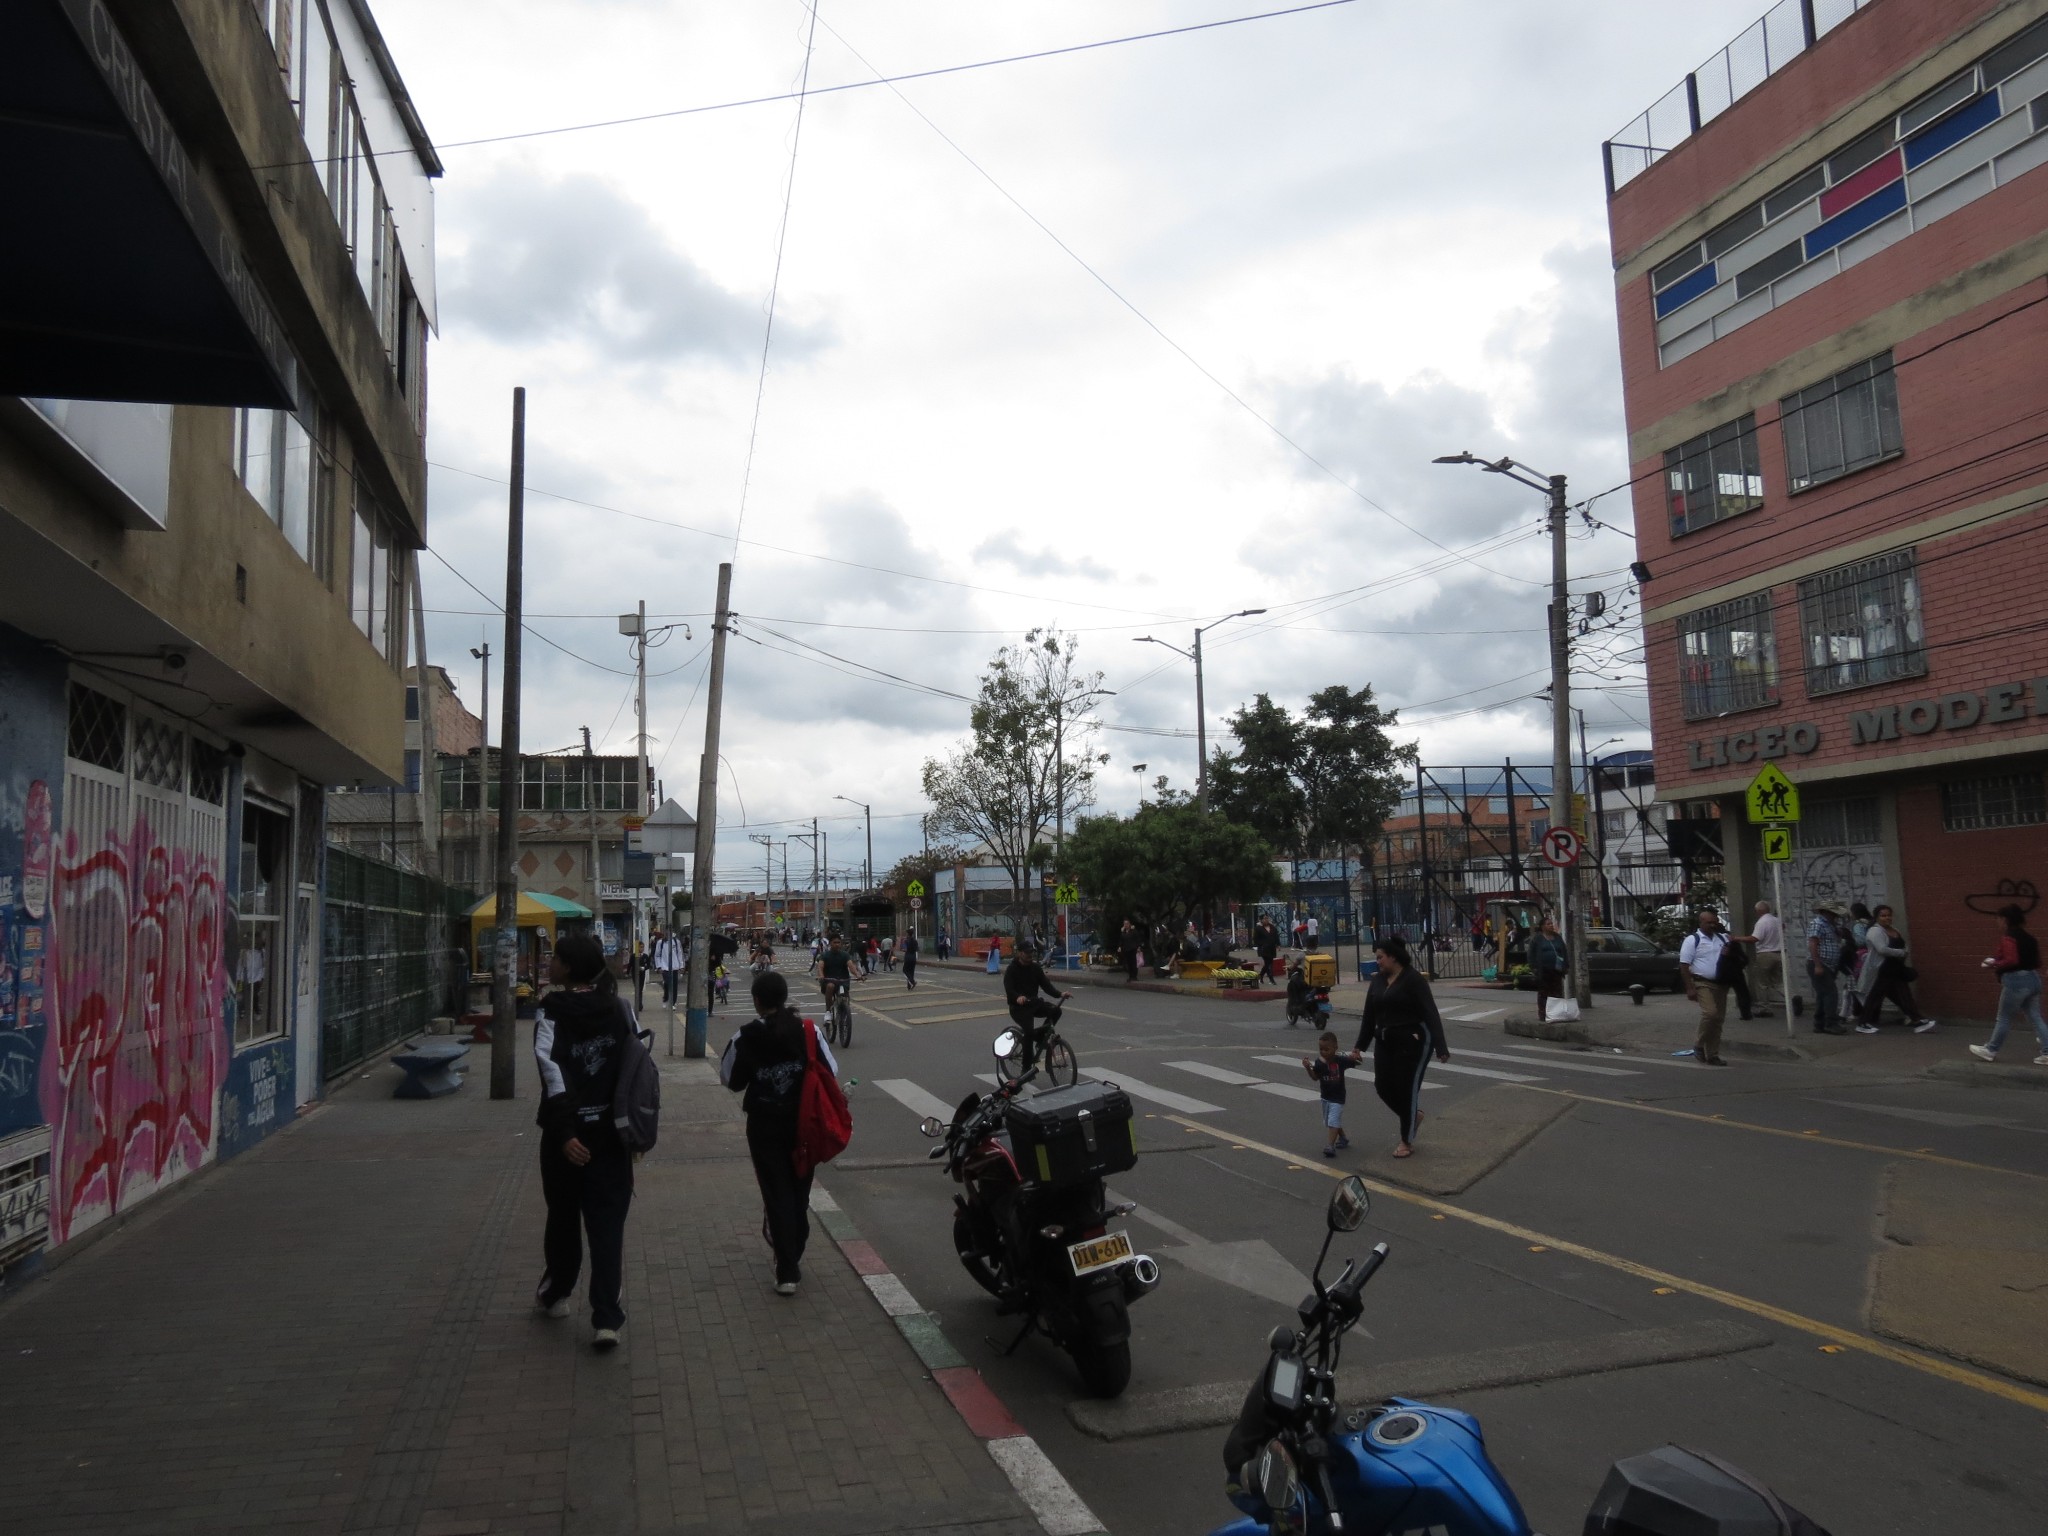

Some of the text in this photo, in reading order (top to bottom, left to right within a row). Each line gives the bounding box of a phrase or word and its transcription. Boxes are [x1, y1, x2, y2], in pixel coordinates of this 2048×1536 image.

[88, 0, 195, 222] CRISTAL
[1687, 675, 2048, 771] LICEO MODE
[249, 1056, 267, 1083] VIVE
[253, 1074, 276, 1105] PODER
